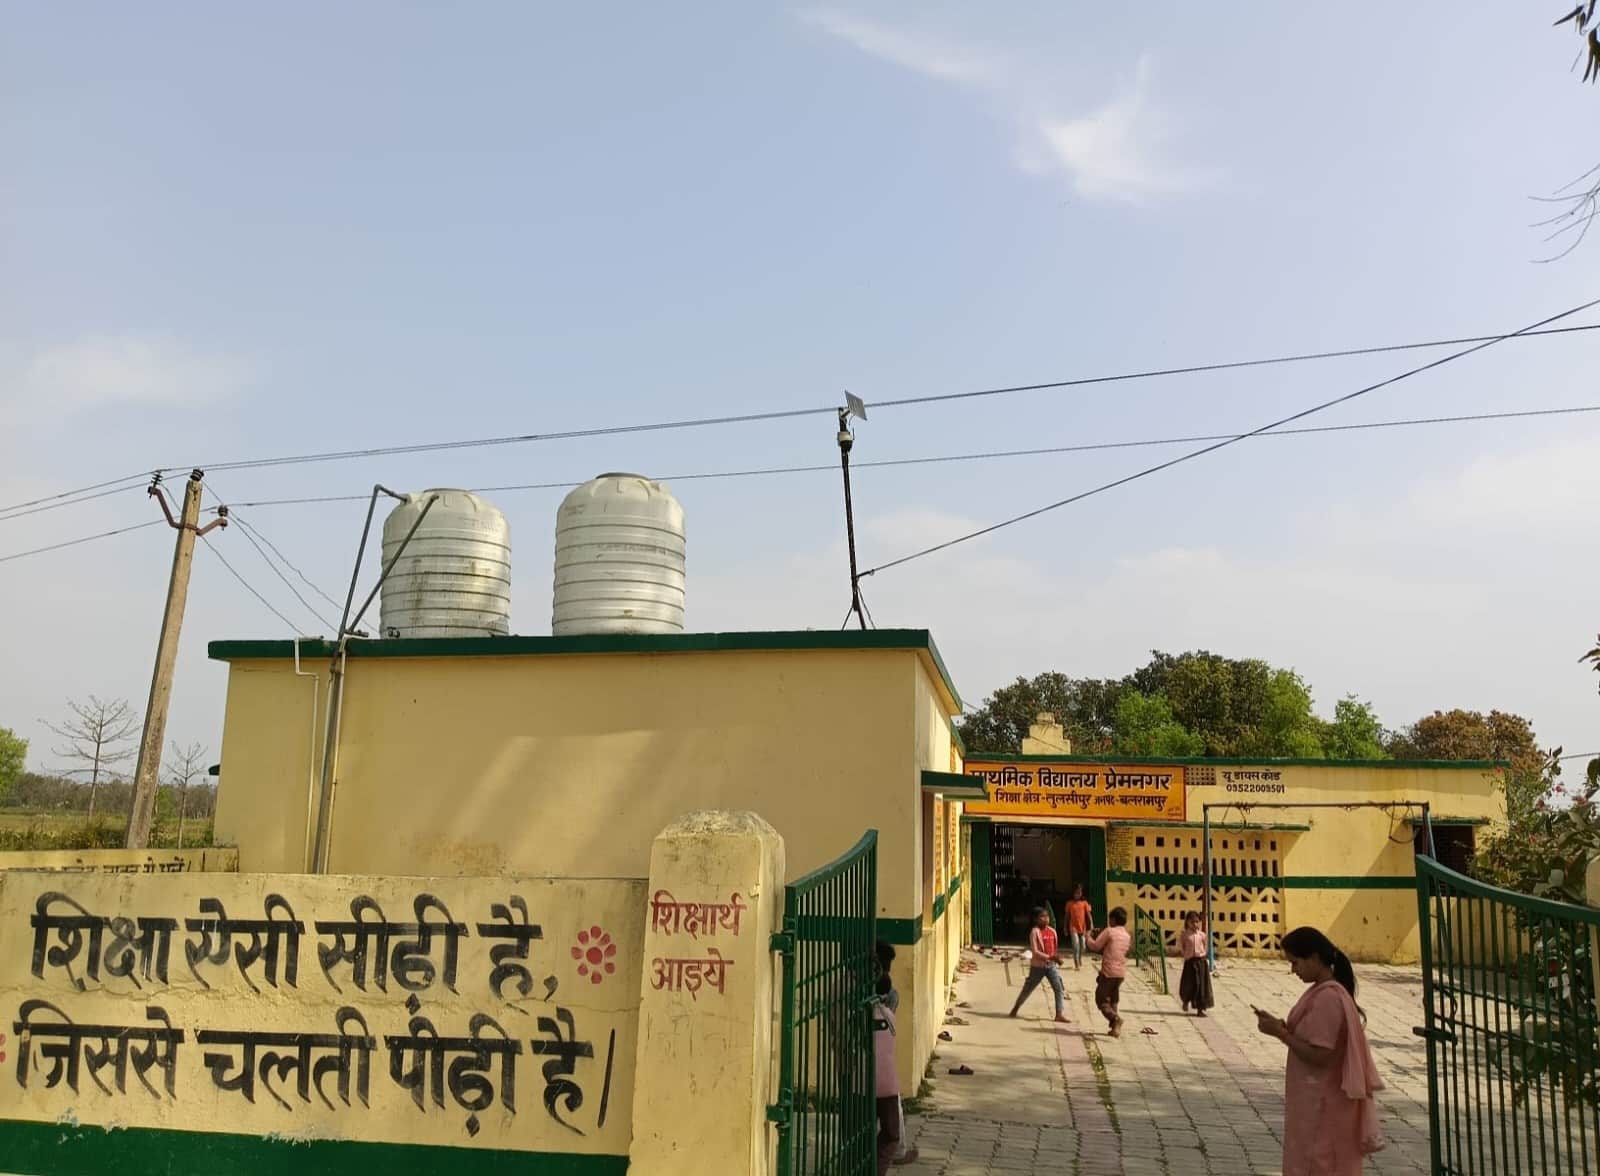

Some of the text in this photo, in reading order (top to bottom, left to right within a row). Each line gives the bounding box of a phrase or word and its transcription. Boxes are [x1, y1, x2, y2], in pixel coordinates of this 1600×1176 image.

[969, 766, 1173, 790] ाथमिक विद्यालय प्रेमनगर
[994, 787, 1021, 803] शिक्षा
[1221, 771, 1235, 783] यू
[651, 889, 747, 940] शिक्षार्थ
[31, 891, 179, 991] शिक्षा
[315, 893, 468, 1014] सीढ़ी
[650, 947, 735, 1002] आइये
[13, 999, 184, 1099] जिससे
[194, 1006, 377, 1111] चलती
[384, 1010, 523, 1138] पीढ़ी
